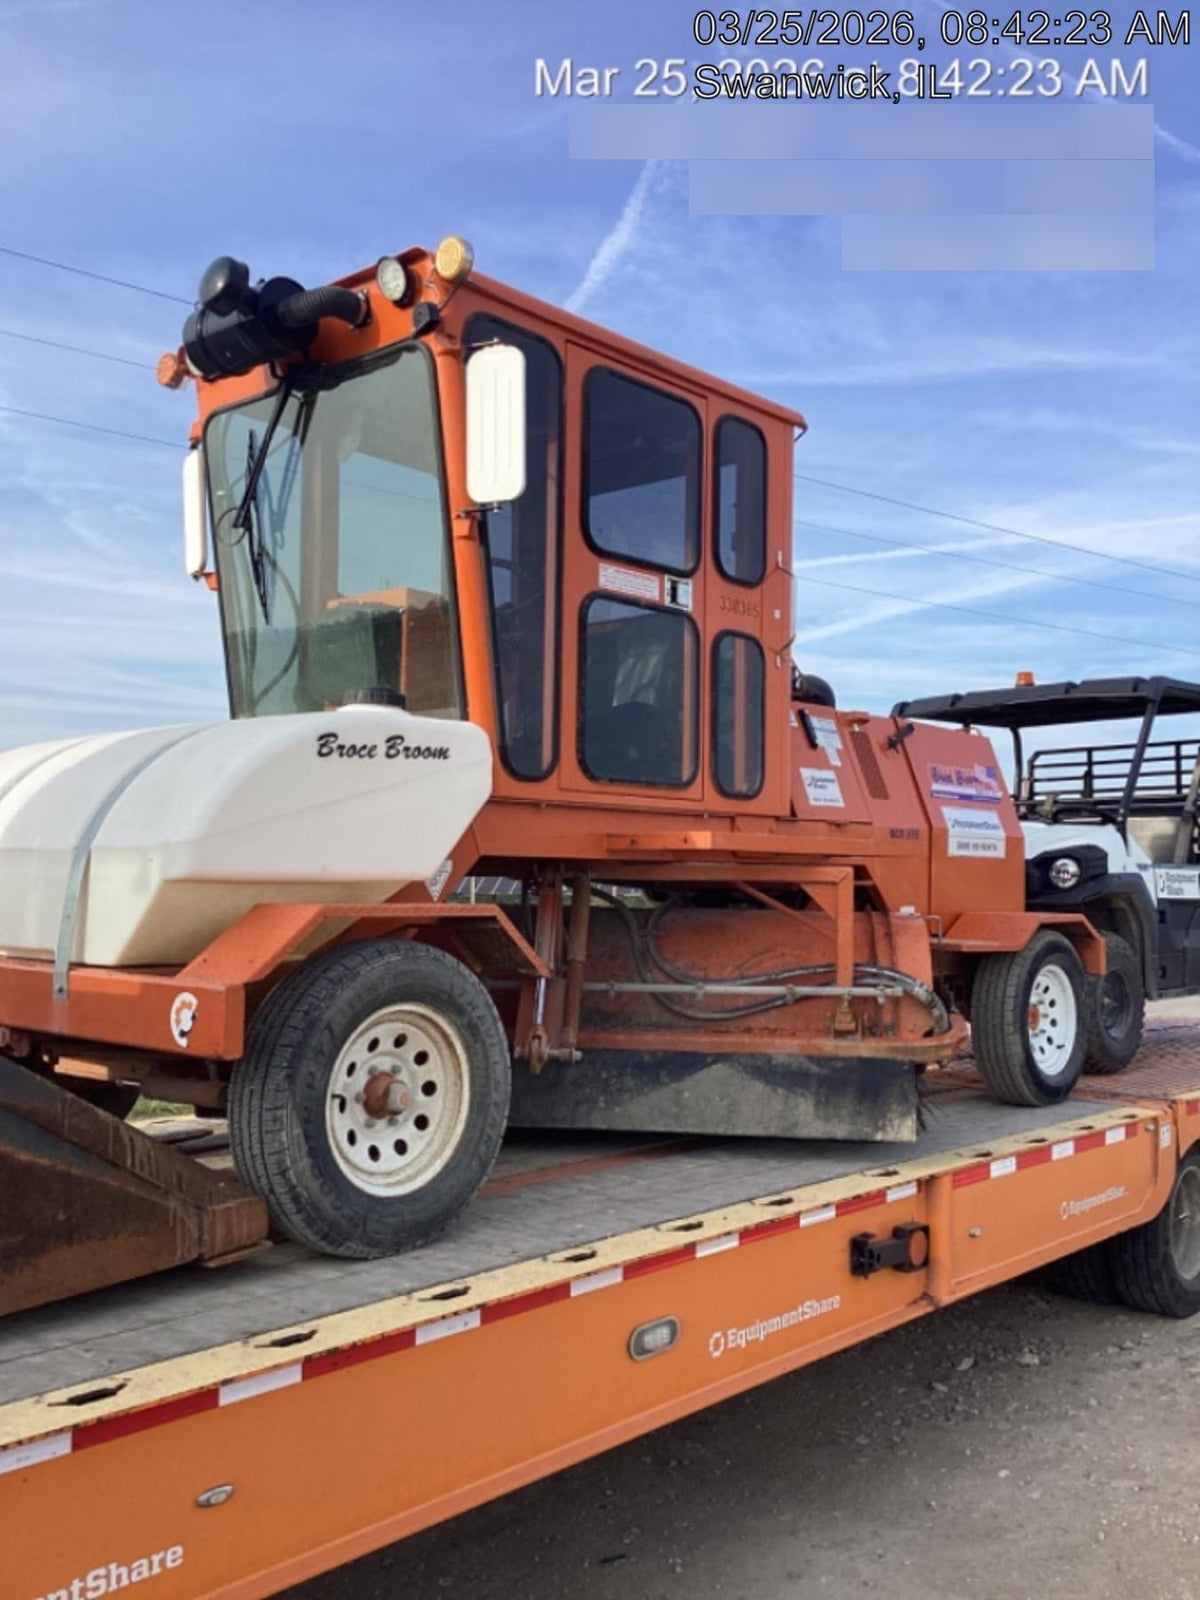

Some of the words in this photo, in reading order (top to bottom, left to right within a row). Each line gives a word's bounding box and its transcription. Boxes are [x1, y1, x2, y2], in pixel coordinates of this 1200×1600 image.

[316, 732, 378, 759] Broce
[385, 734, 450, 760] Broom
[727, 1295, 841, 1349] EquipmentShare
[33, 1544, 184, 1600] ntShare
